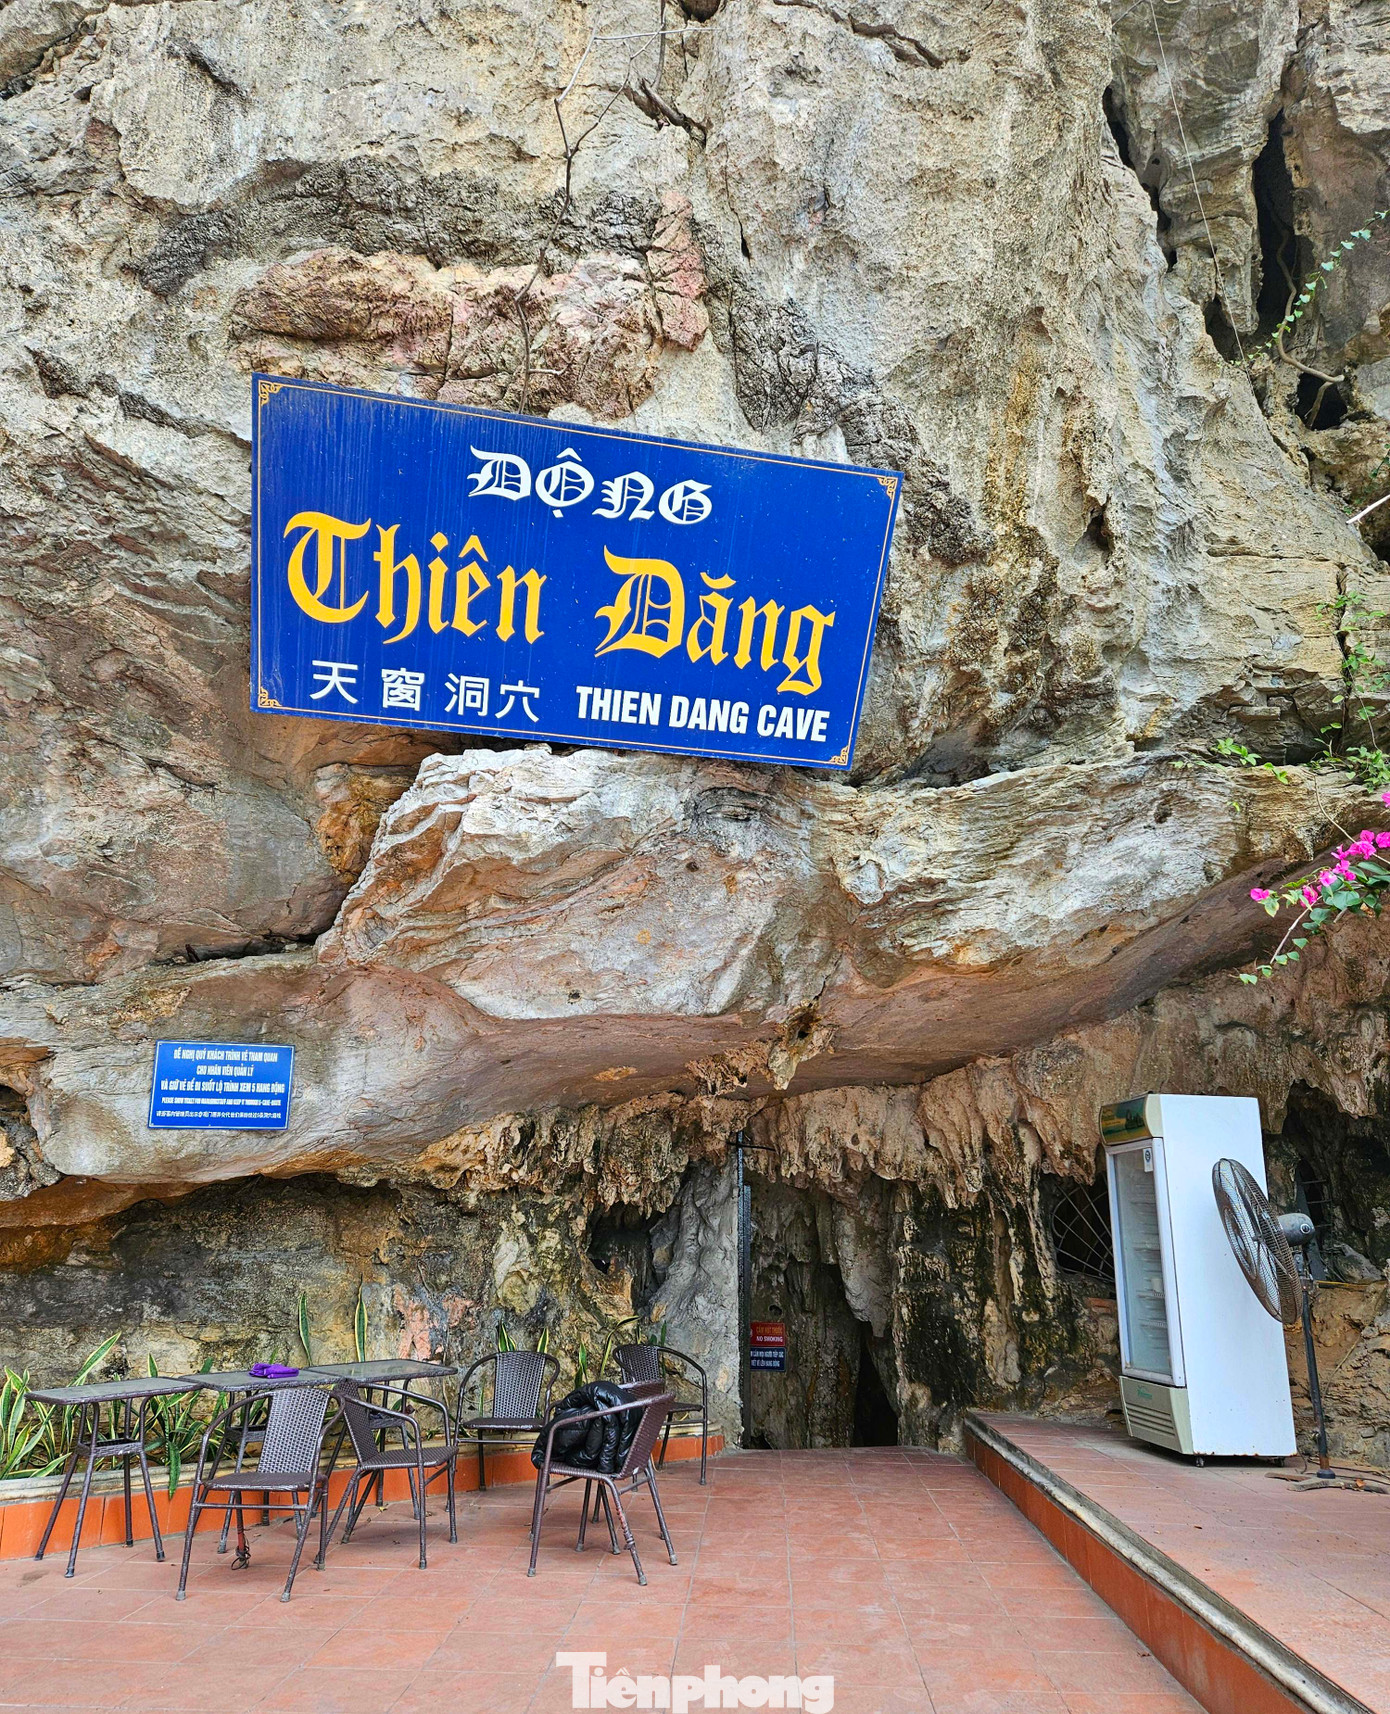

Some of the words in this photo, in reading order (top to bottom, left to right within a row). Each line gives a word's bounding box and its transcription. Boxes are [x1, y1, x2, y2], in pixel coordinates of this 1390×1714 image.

[283, 511, 548, 644] Thiên
[576, 685, 661, 728] THIEN
[669, 695, 750, 735] DANG
[757, 704, 830, 743] CAVE
[240, 1083, 251, 1092] XEM
[252, 1083, 255, 1092] 5
